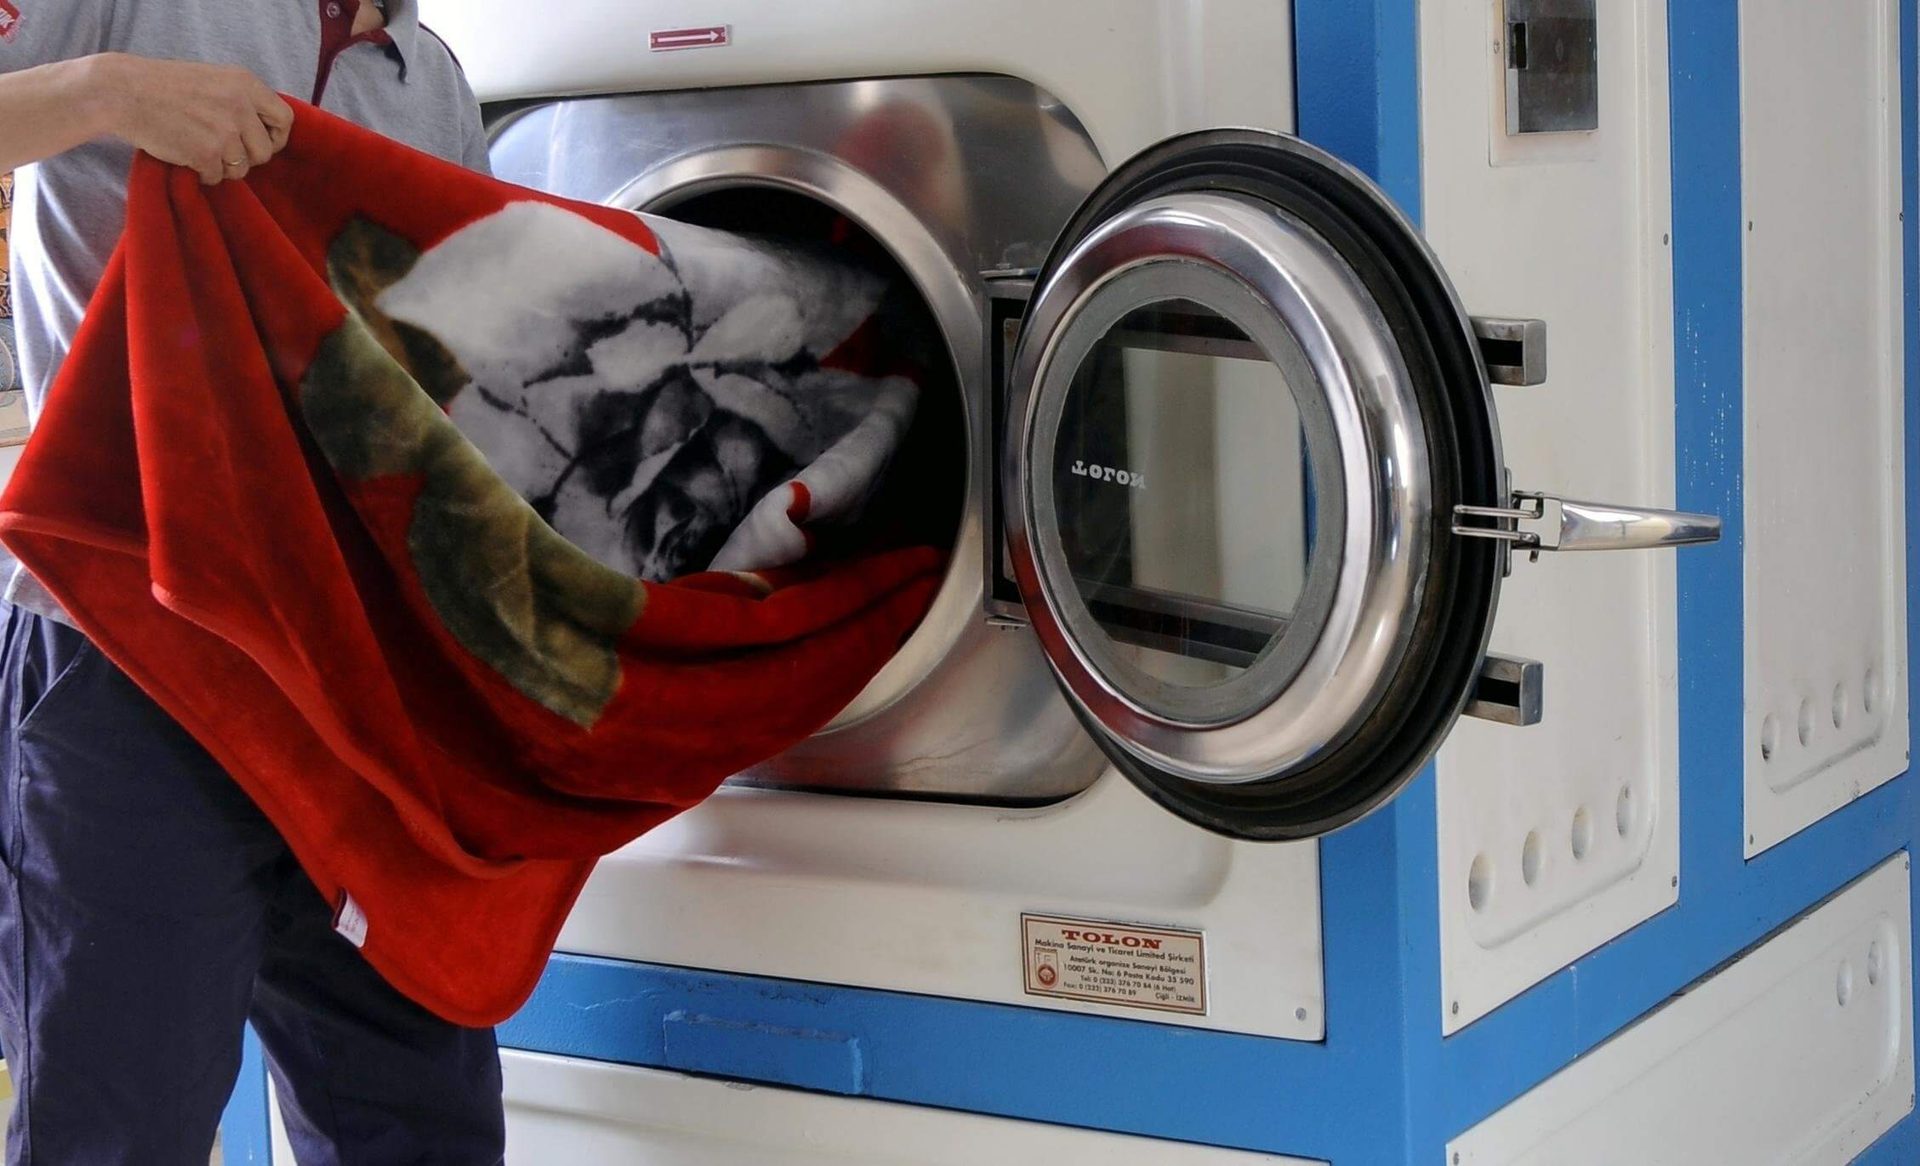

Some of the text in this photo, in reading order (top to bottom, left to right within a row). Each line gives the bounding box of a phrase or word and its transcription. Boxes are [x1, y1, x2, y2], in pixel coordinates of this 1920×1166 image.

[1035, 938, 1064, 948] Makina
[1067, 942, 1093, 953] Sanayi
[1108, 946, 1133, 956] Ticaret
[1136, 949, 1165, 959] Limited
[1061, 930, 1162, 949] TOLON
[1064, 963, 1085, 972] 10007
[1123, 970, 1143, 979] Posta
